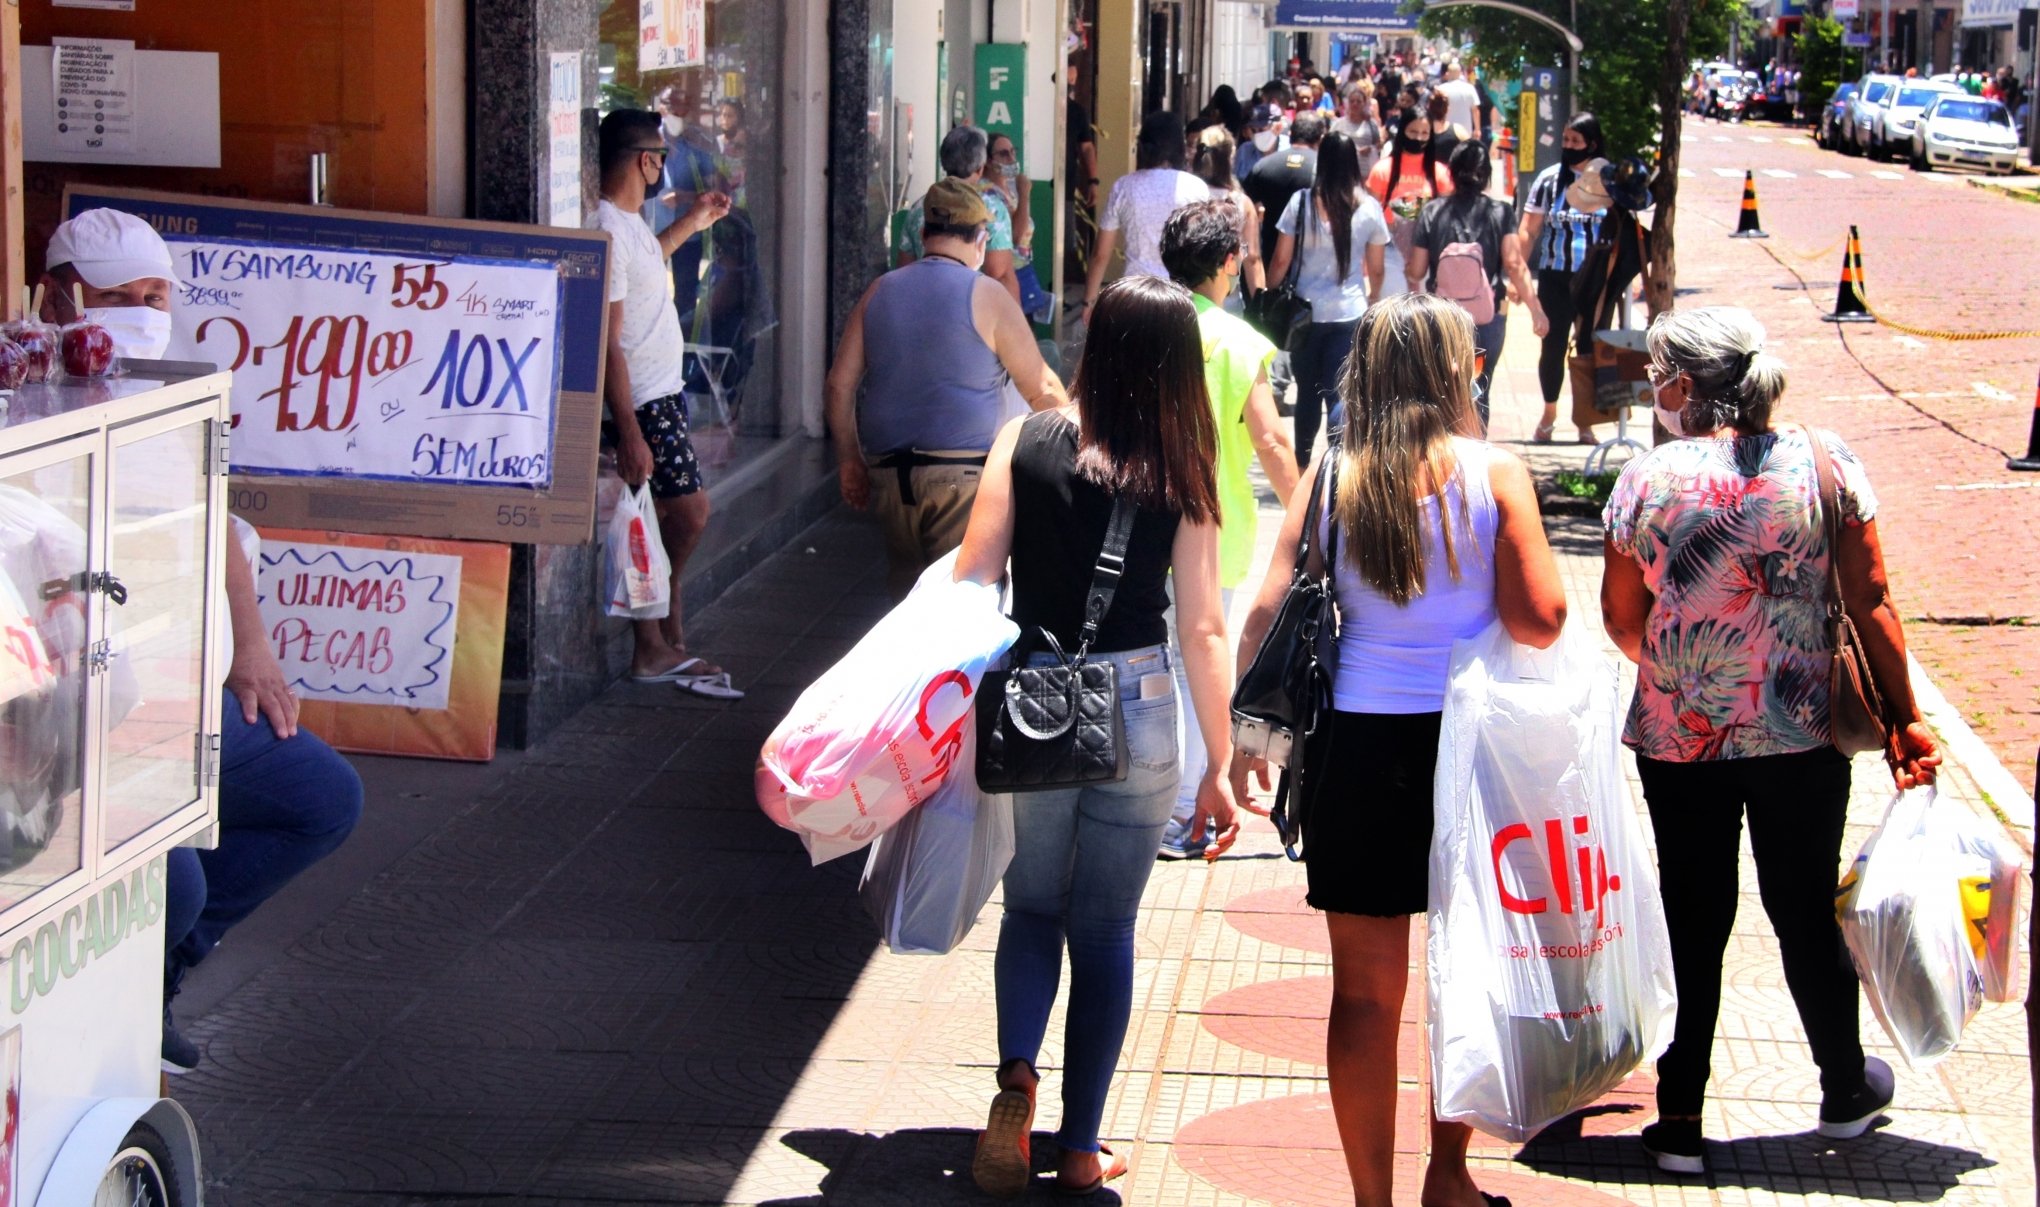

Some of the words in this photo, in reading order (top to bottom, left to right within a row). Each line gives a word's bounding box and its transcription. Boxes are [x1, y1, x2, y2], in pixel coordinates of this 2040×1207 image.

[1293, 14, 1321, 23] Compre
[60, 44, 103, 52] INFORMAÇÕES
[60, 52, 93, 60] SANITÁRIAS
[95, 53, 114, 61] SOBRE
[60, 59, 103, 68] HIGIENIZAÇÃO
[60, 67, 91, 75] CUIDADOS
[60, 74, 96, 83] PREVENÇÃO
[86, 137, 103, 148] taQi
[181, 246, 220, 279] TV
[220, 250, 377, 294] SAMSUNG
[391, 262, 450, 311] 55
[456, 280, 488, 314] 4K
[492, 297, 537, 313] SMART
[420, 328, 542, 412] 10X
[411, 433, 477, 477] SEM
[278, 572, 406, 614] ULTIMAS
[272, 617, 394, 676] PEÇAS
[10, 856, 165, 1015] COCADAS
